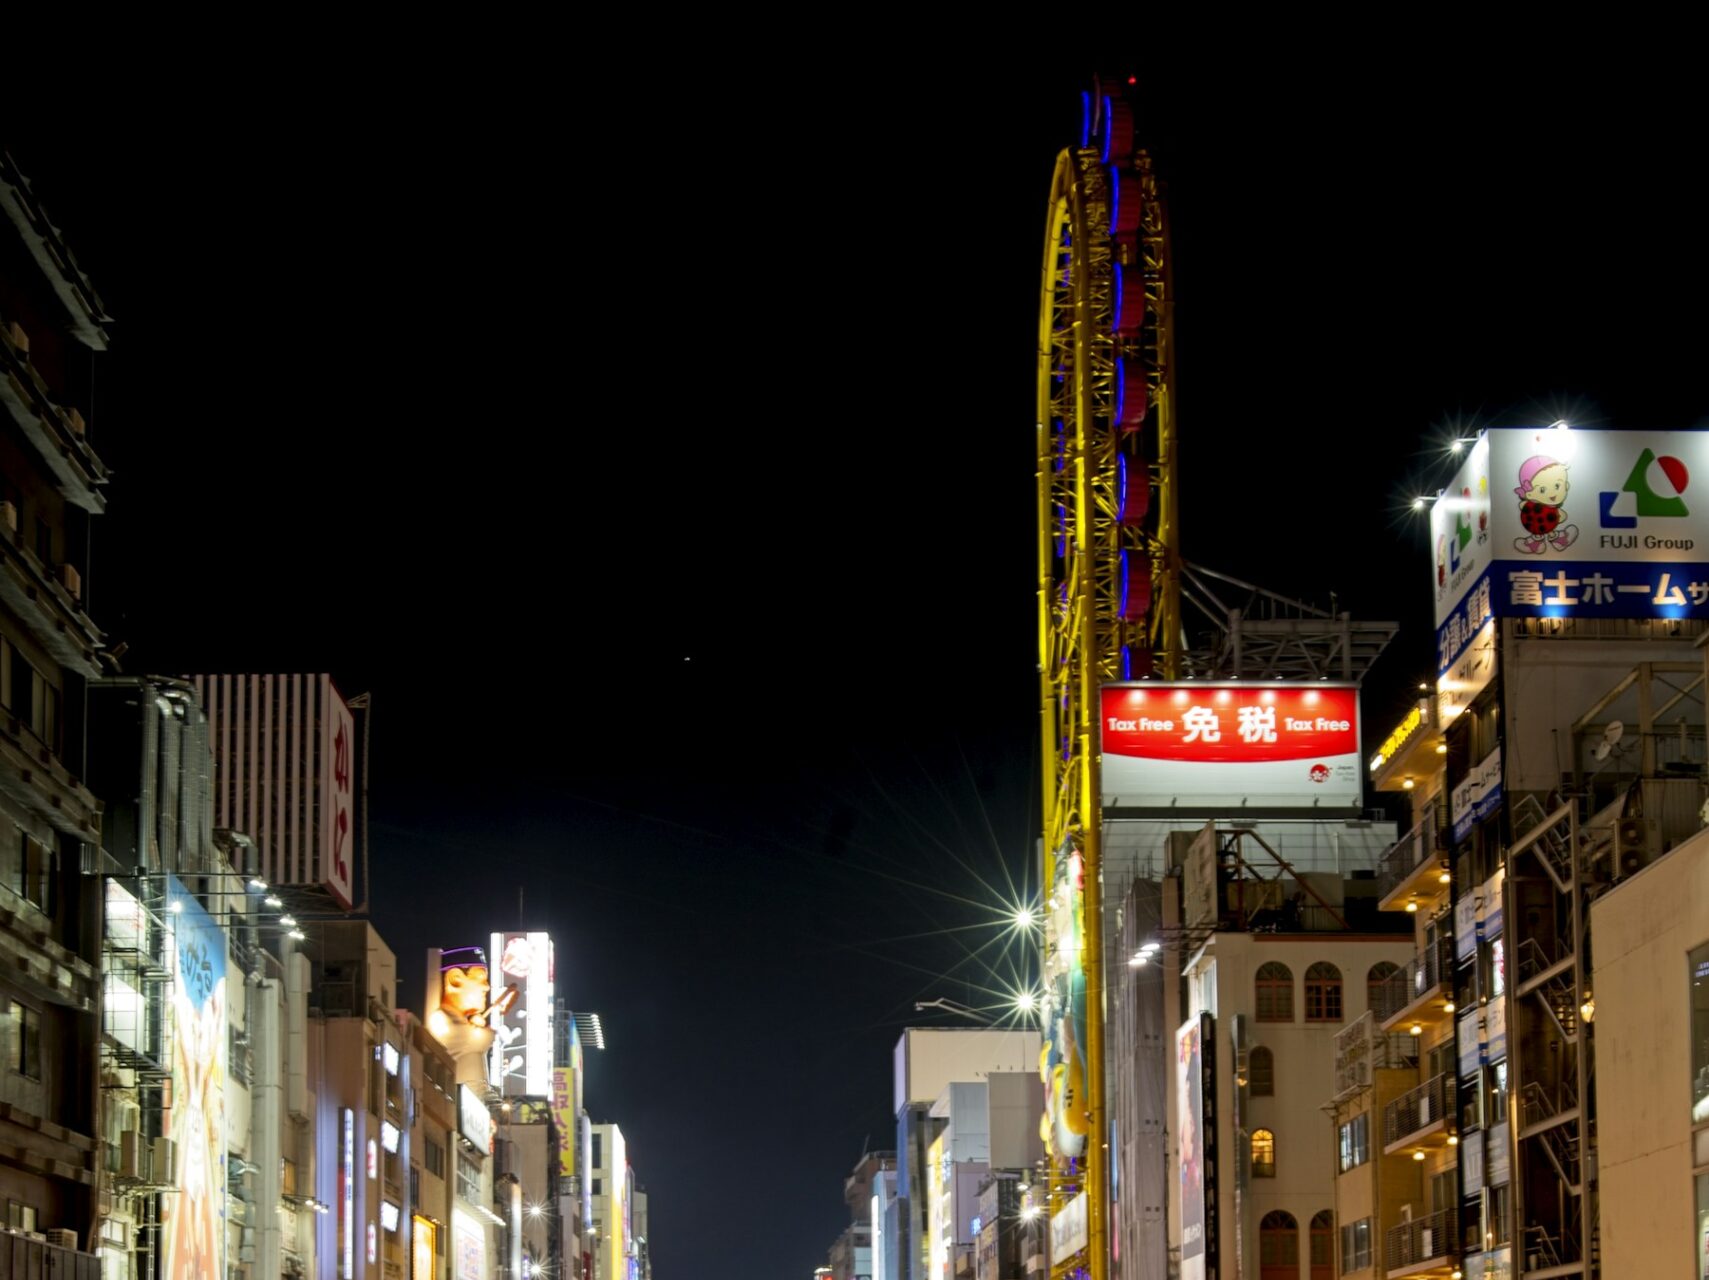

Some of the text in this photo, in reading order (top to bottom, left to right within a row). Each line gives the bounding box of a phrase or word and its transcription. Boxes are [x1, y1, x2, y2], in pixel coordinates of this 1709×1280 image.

[1600, 535, 1694, 551] FUJI Group
[1107, 717, 1136, 731] Tax
[1139, 717, 1174, 731] Free
[1284, 717, 1314, 731] Tax
[1316, 717, 1350, 731] Free
